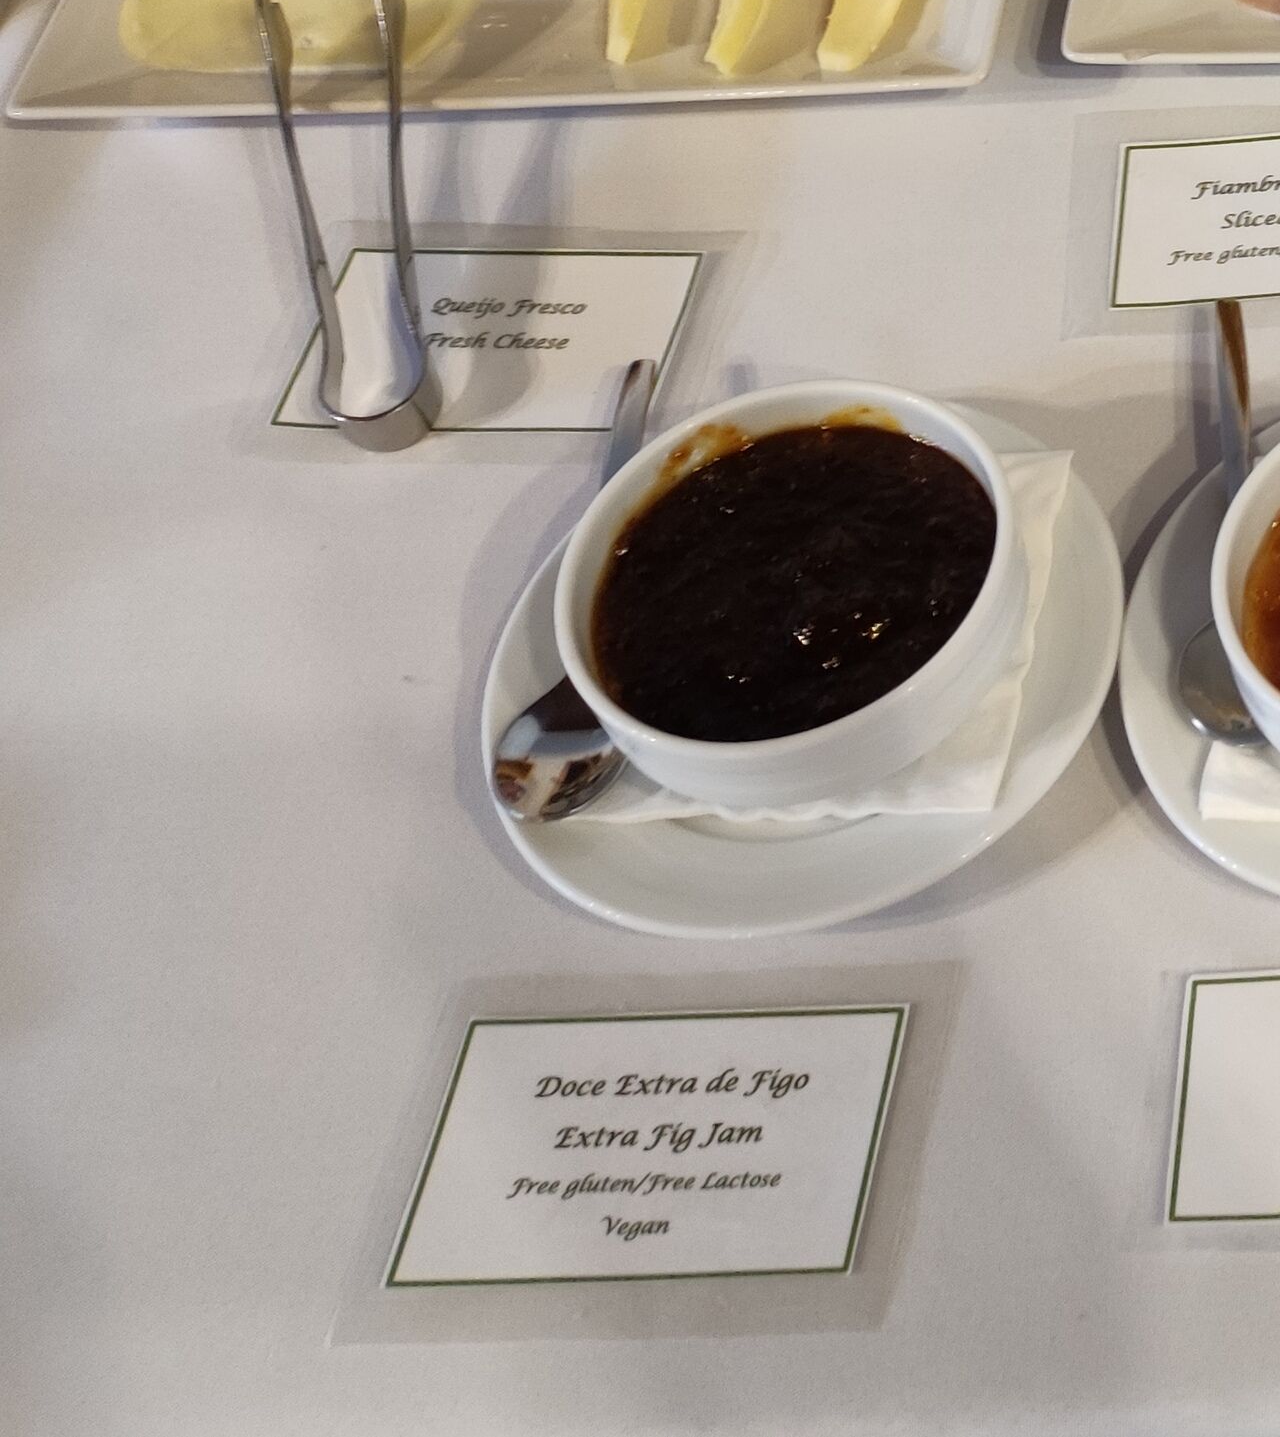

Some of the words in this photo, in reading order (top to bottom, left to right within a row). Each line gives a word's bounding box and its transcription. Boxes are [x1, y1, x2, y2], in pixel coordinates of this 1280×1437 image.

[1166, 249, 1212, 266] Free
[431, 297, 505, 319] Queijo
[507, 299, 588, 317] Fresco
[425, 331, 490, 348] Fresh
[493, 332, 570, 349] Cheese
[533, 1075, 606, 1099] Doce
[613, 1072, 698, 1097] Extra
[705, 1067, 740, 1094] de
[743, 1067, 811, 1099] Figo
[553, 1123, 639, 1150] Extra
[643, 1122, 700, 1154] Fig
[699, 1120, 765, 1150] Jam
[506, 1175, 561, 1201] Free
[563, 1170, 696, 1202] gluten/Free
[701, 1169, 782, 1191] Lactose
[600, 1215, 671, 1243] Vegan
